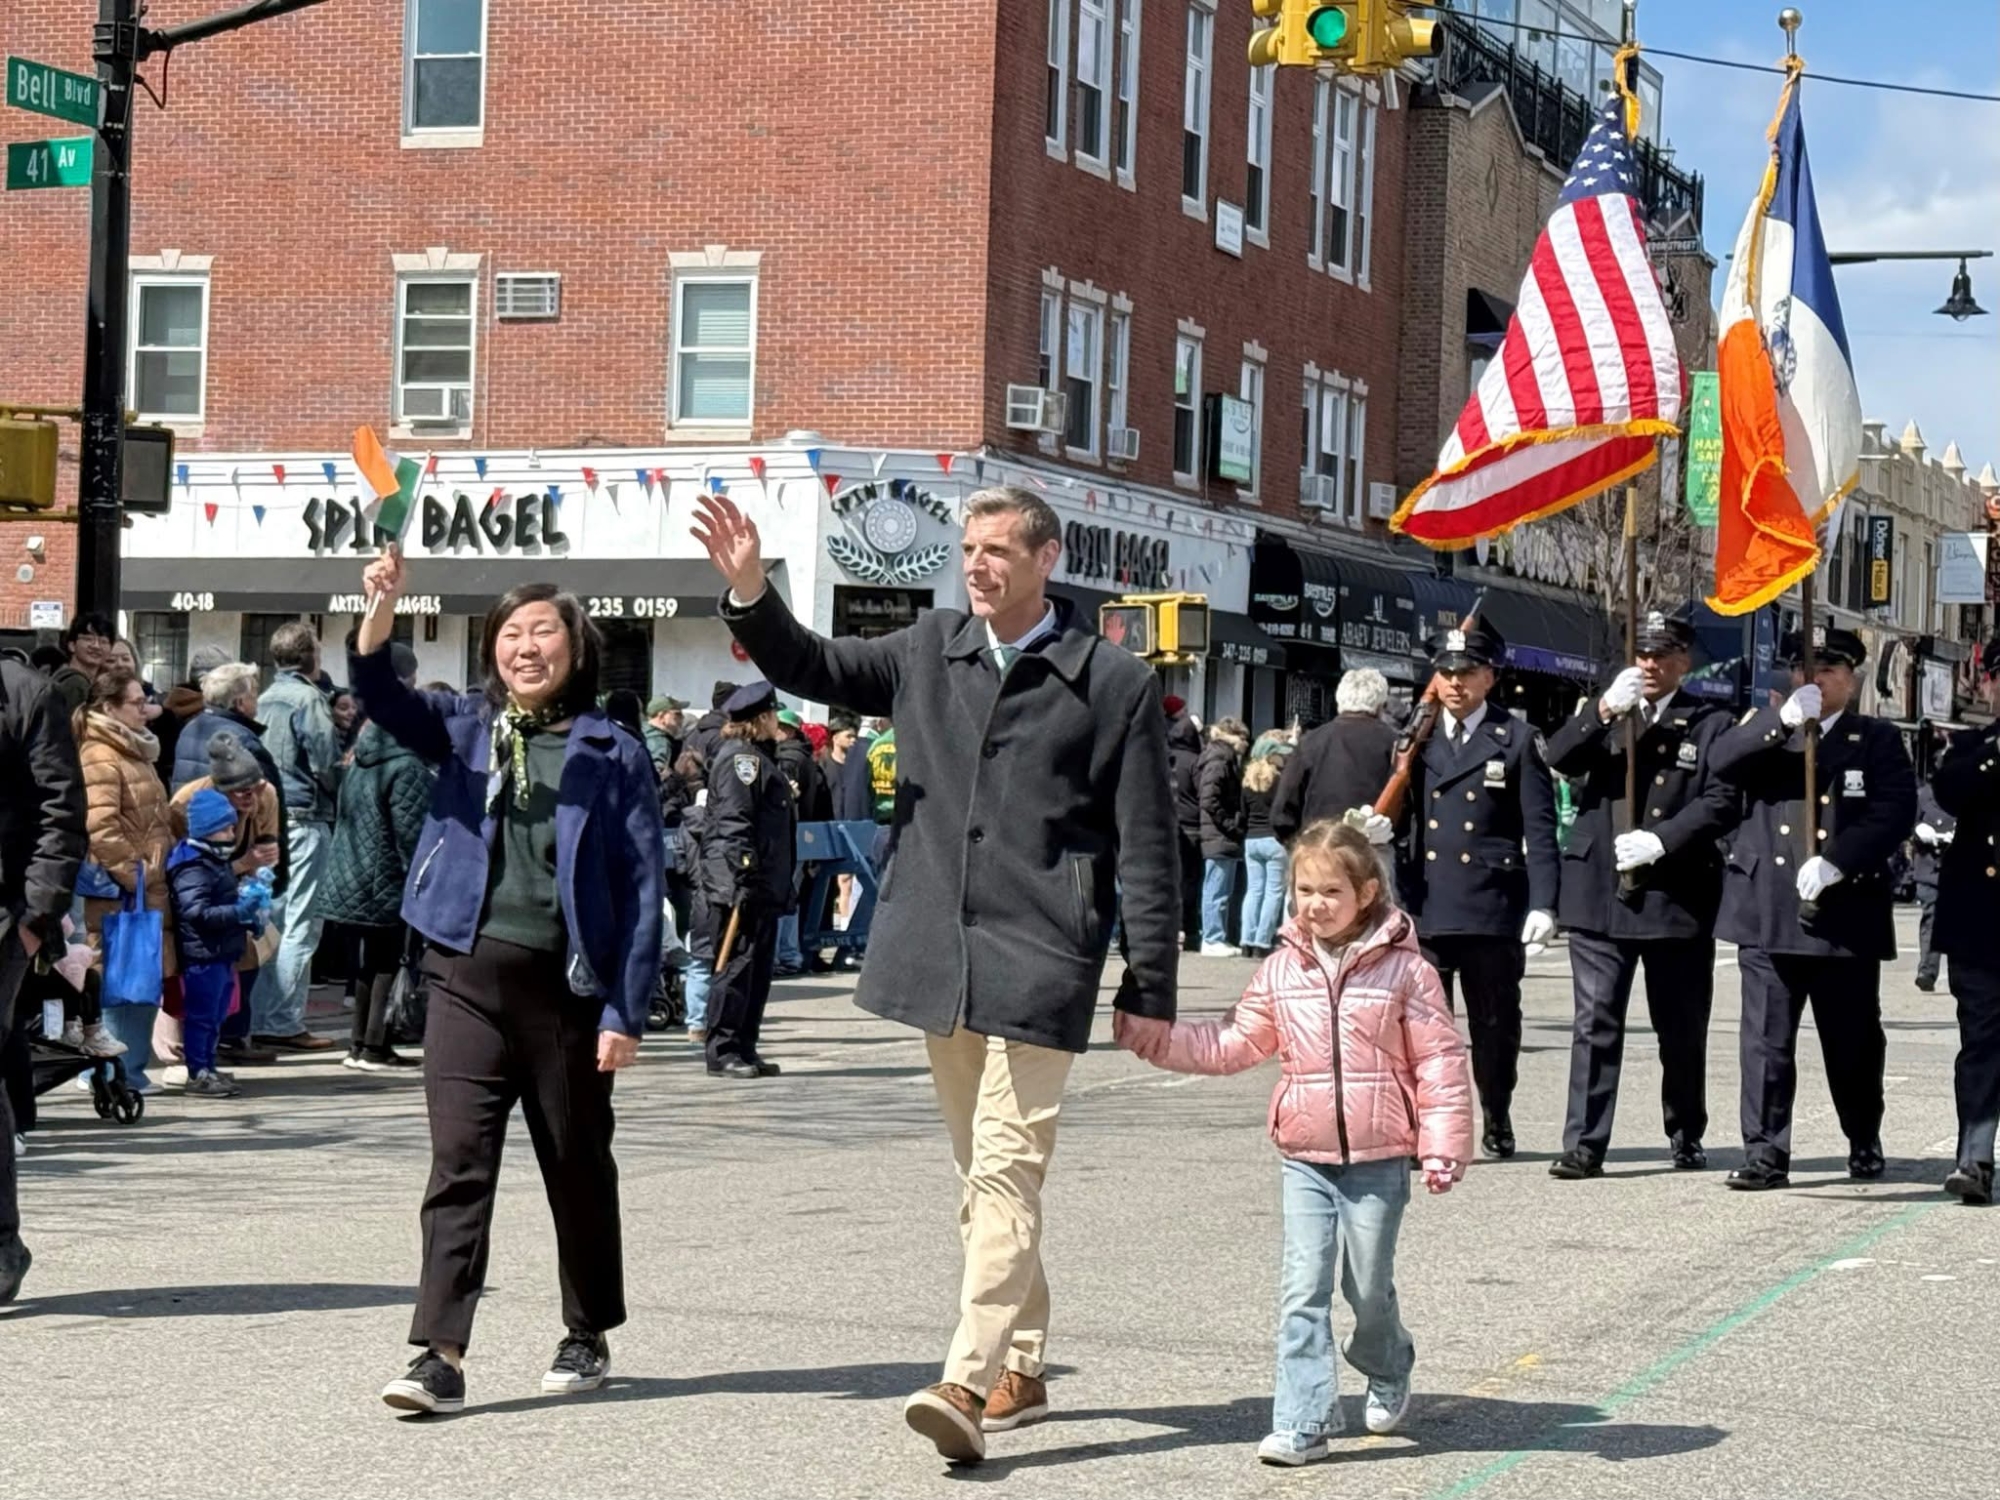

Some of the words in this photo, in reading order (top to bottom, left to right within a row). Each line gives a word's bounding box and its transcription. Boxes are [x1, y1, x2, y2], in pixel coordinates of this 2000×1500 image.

[17, 64, 56, 110] Bell
[64, 77, 91, 106] Blvd
[26, 148, 48, 182] 41
[58, 145, 76, 168] Av
[1694, 438, 1721, 450] HAP
[831, 481, 877, 517] SPIN
[422, 494, 568, 551] BAGEL
[1065, 520, 1111, 578] SPIN
[171, 592, 215, 611] 40-18
[328, 594, 369, 613] ARTIS
[588, 597, 624, 617] 235
[633, 597, 678, 617] 0159
